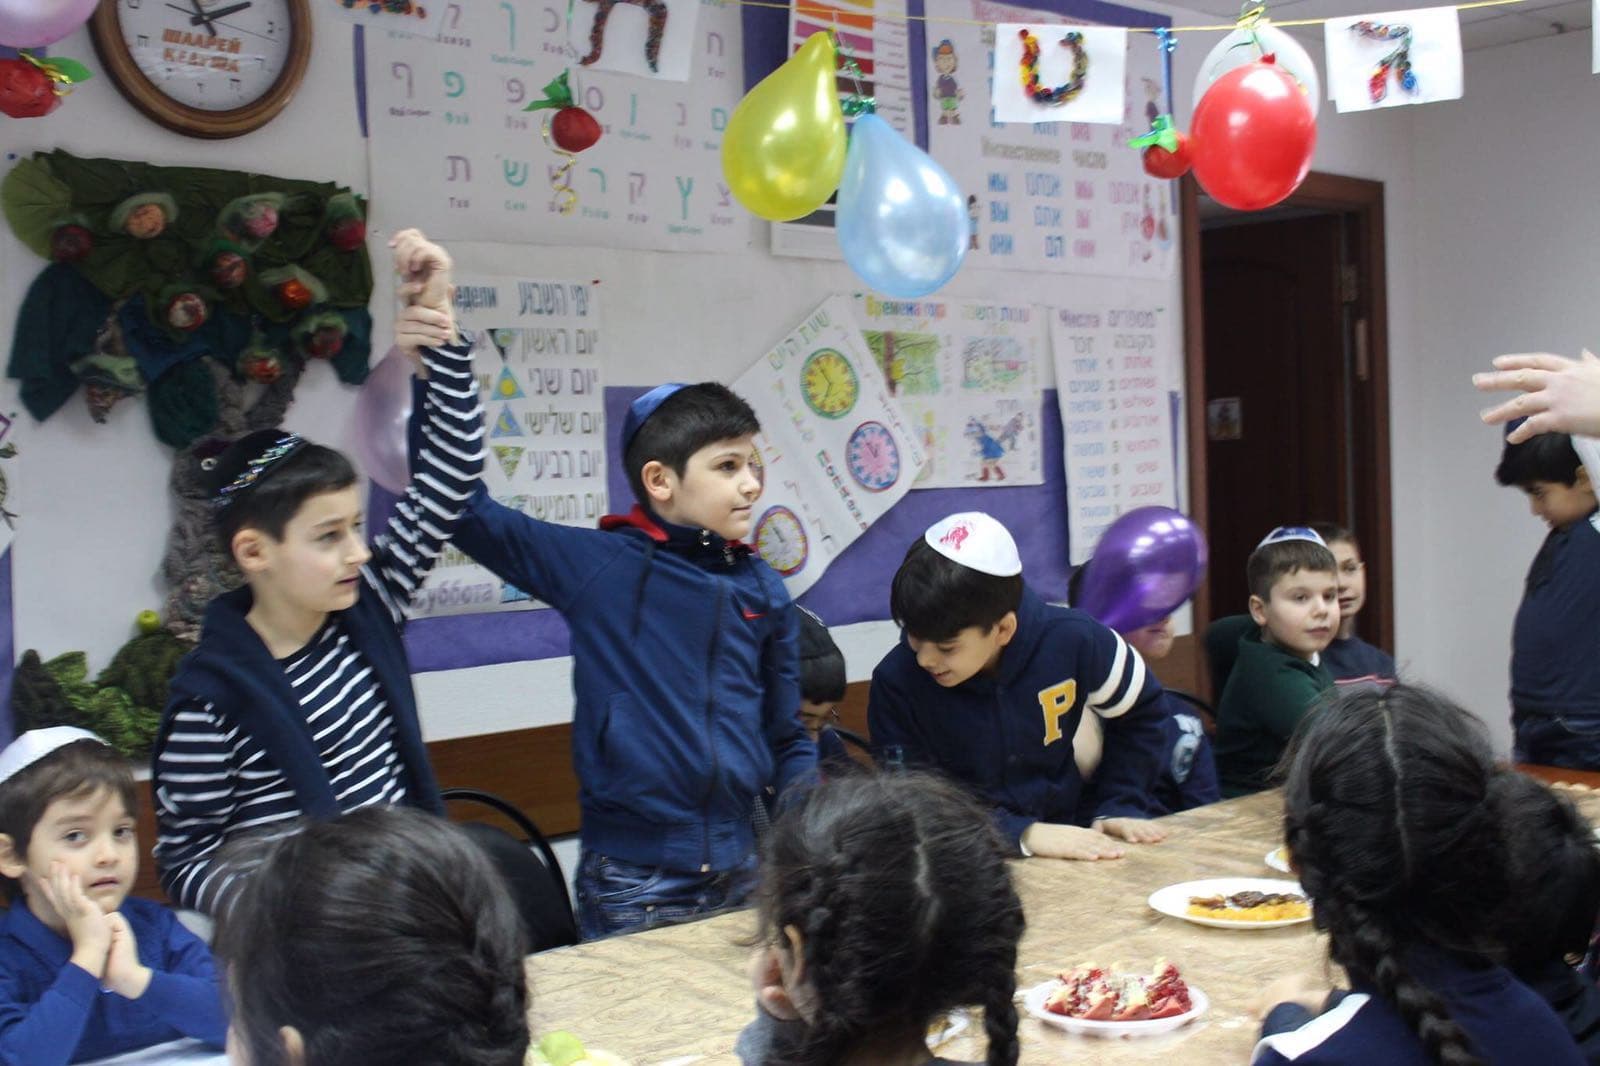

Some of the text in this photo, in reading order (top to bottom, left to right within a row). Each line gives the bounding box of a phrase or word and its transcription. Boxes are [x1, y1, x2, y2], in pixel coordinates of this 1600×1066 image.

[446, 155, 471, 182] ת
[503, 159, 529, 187] ש
[452, 285, 498, 312] едели
[527, 368, 599, 396] יום שני
[524, 404, 603, 435] יום שלישי
[527, 450, 604, 480] יום רביעי
[1038, 678, 1077, 747] P
